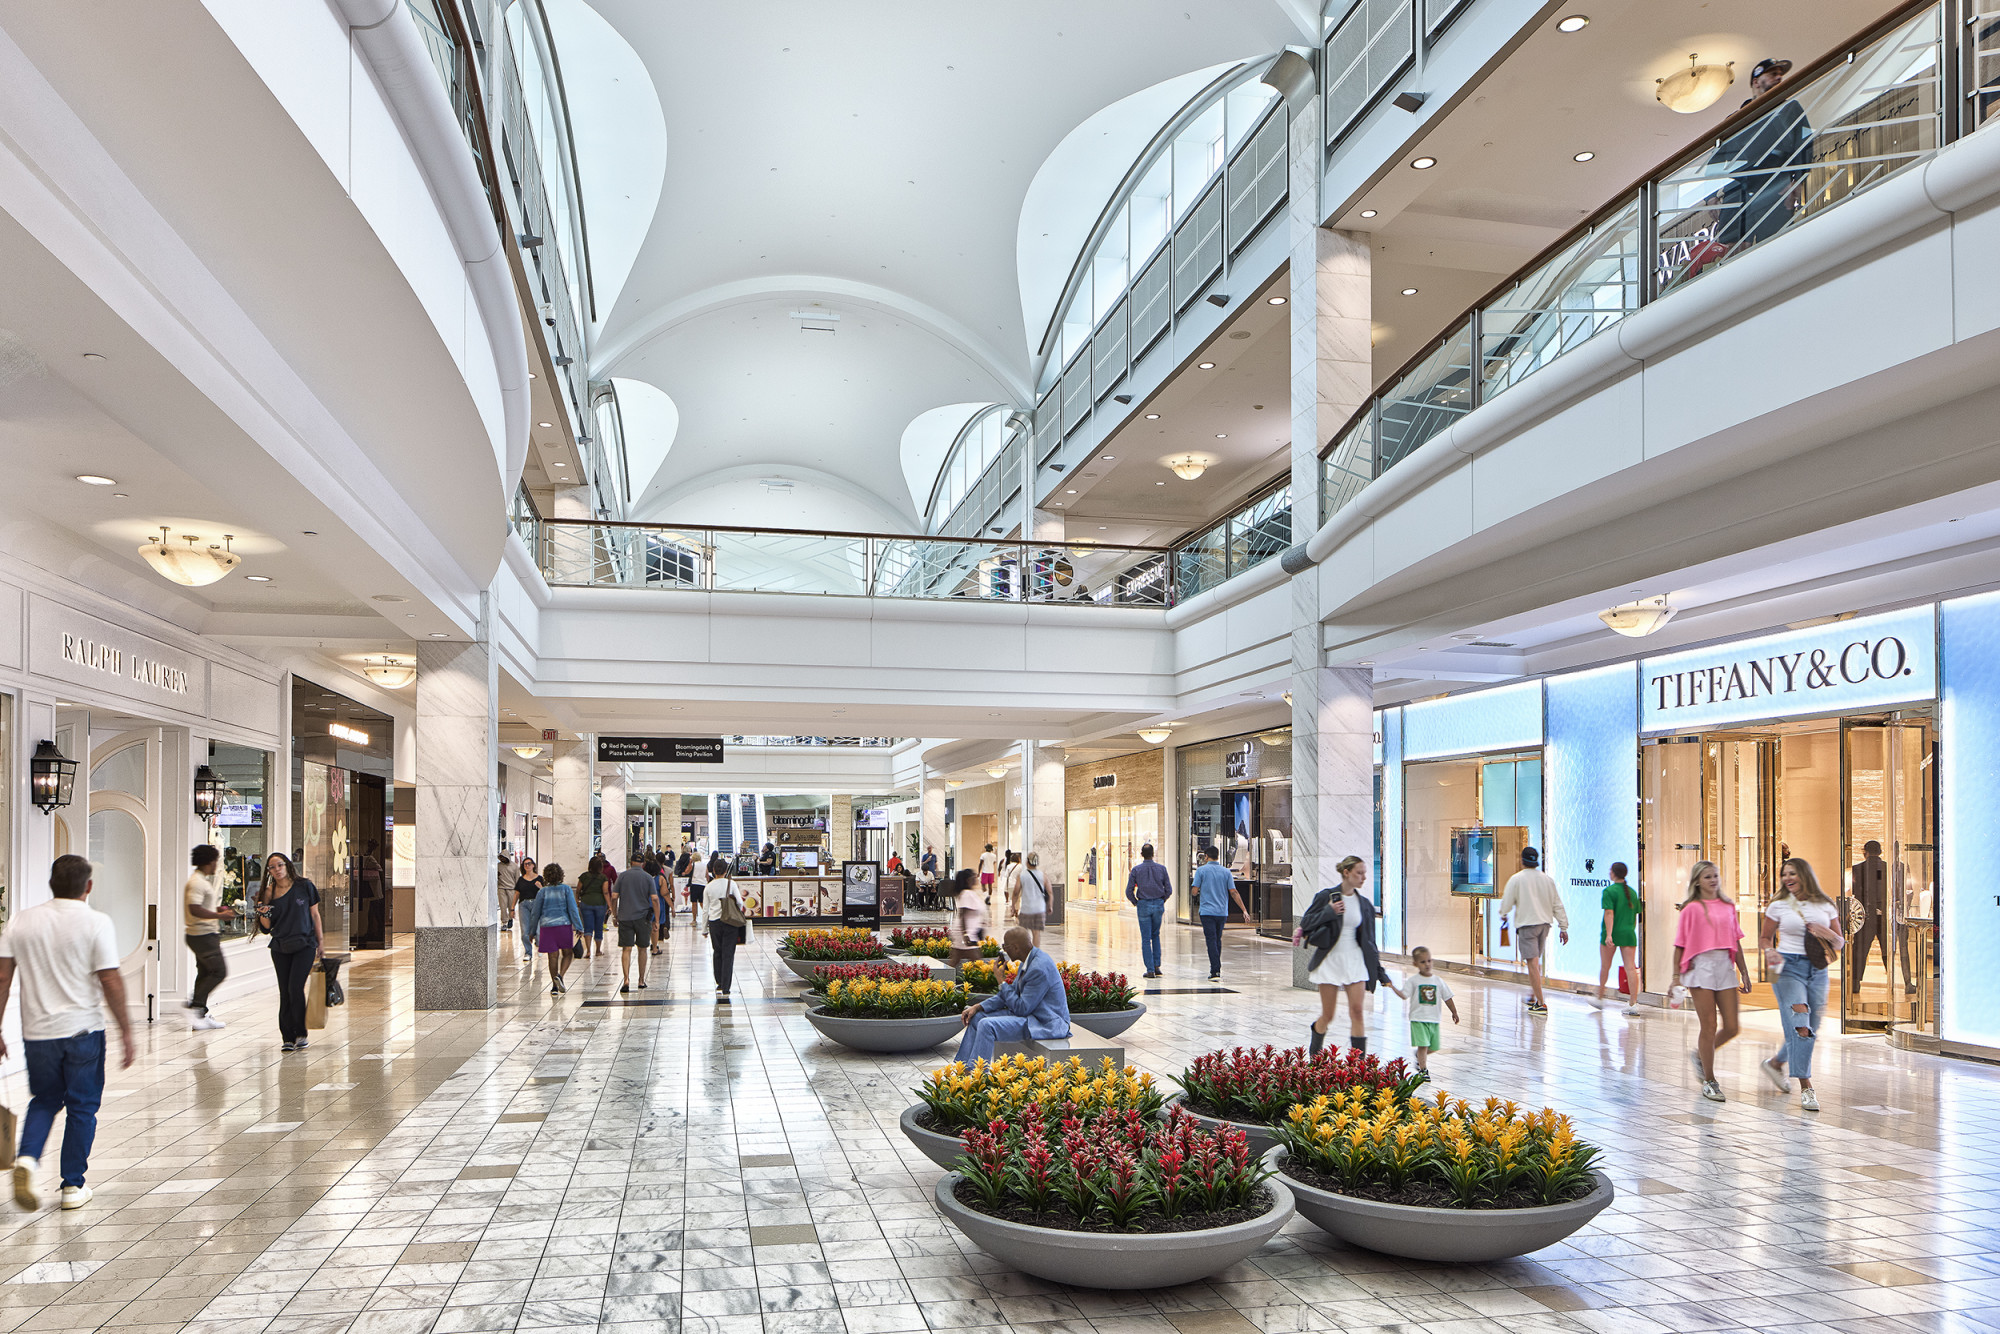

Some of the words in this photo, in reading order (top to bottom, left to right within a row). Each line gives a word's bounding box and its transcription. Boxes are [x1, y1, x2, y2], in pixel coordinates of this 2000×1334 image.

[62, 632, 122, 676] RALPH
[132, 655, 188, 695] LAUREN
[1651, 636, 1912, 711] TIFFANY&CO.
[543, 731, 556, 740] EXIT
[1226, 751, 1246, 765] MONT
[1226, 764, 1246, 778] BLANC
